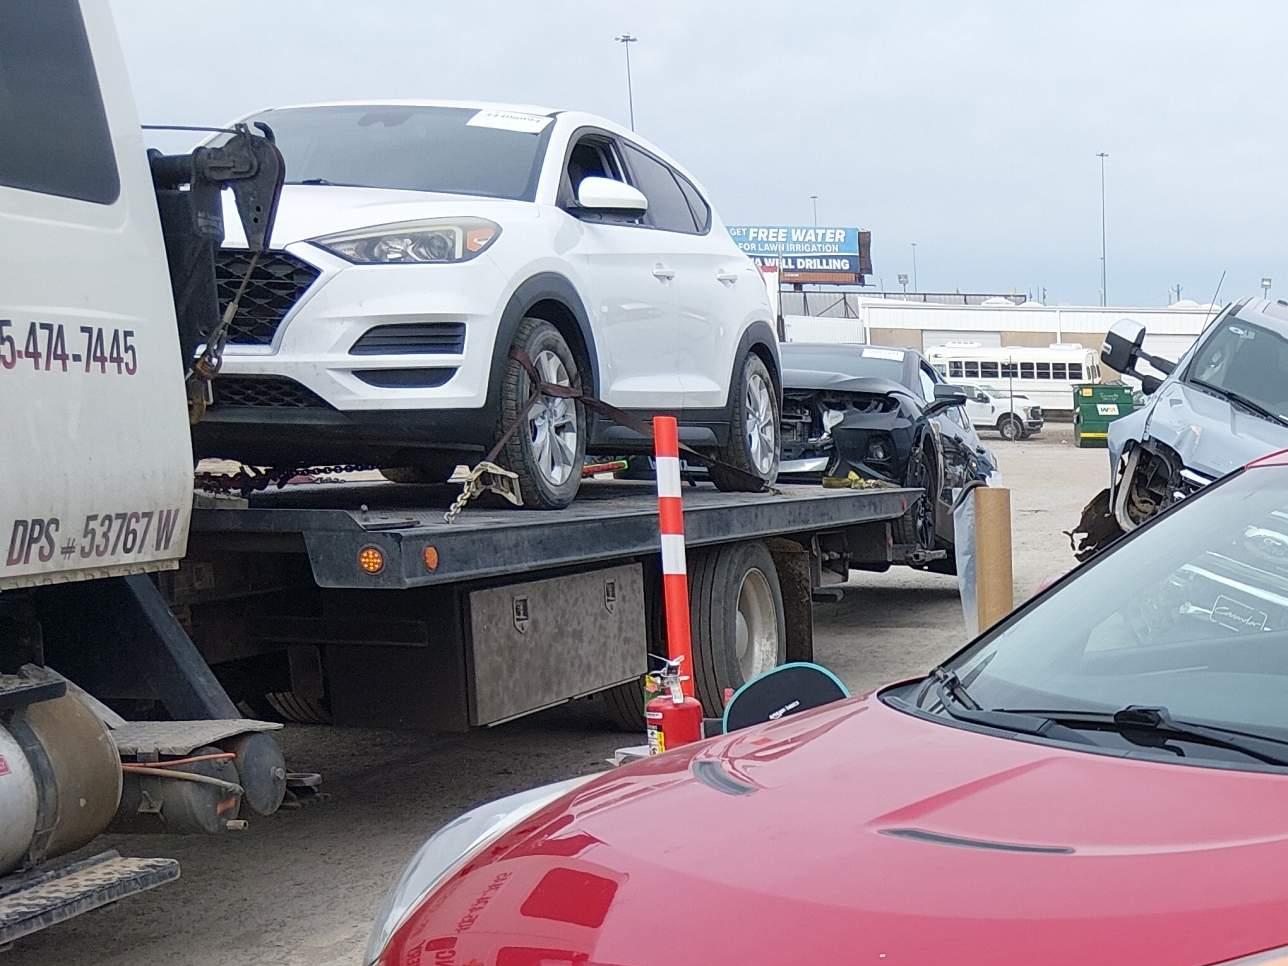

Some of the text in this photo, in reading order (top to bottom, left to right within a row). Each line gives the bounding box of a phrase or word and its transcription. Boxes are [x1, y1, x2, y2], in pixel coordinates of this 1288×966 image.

[730, 227, 846, 243] GET FREE WATER
[738, 242, 839, 253] FOR LAWN IRRIGATION
[796, 258, 850, 270] DRILLING
[0, 319, 138, 376] 5-474-7445
[6, 517, 61, 567] DPS
